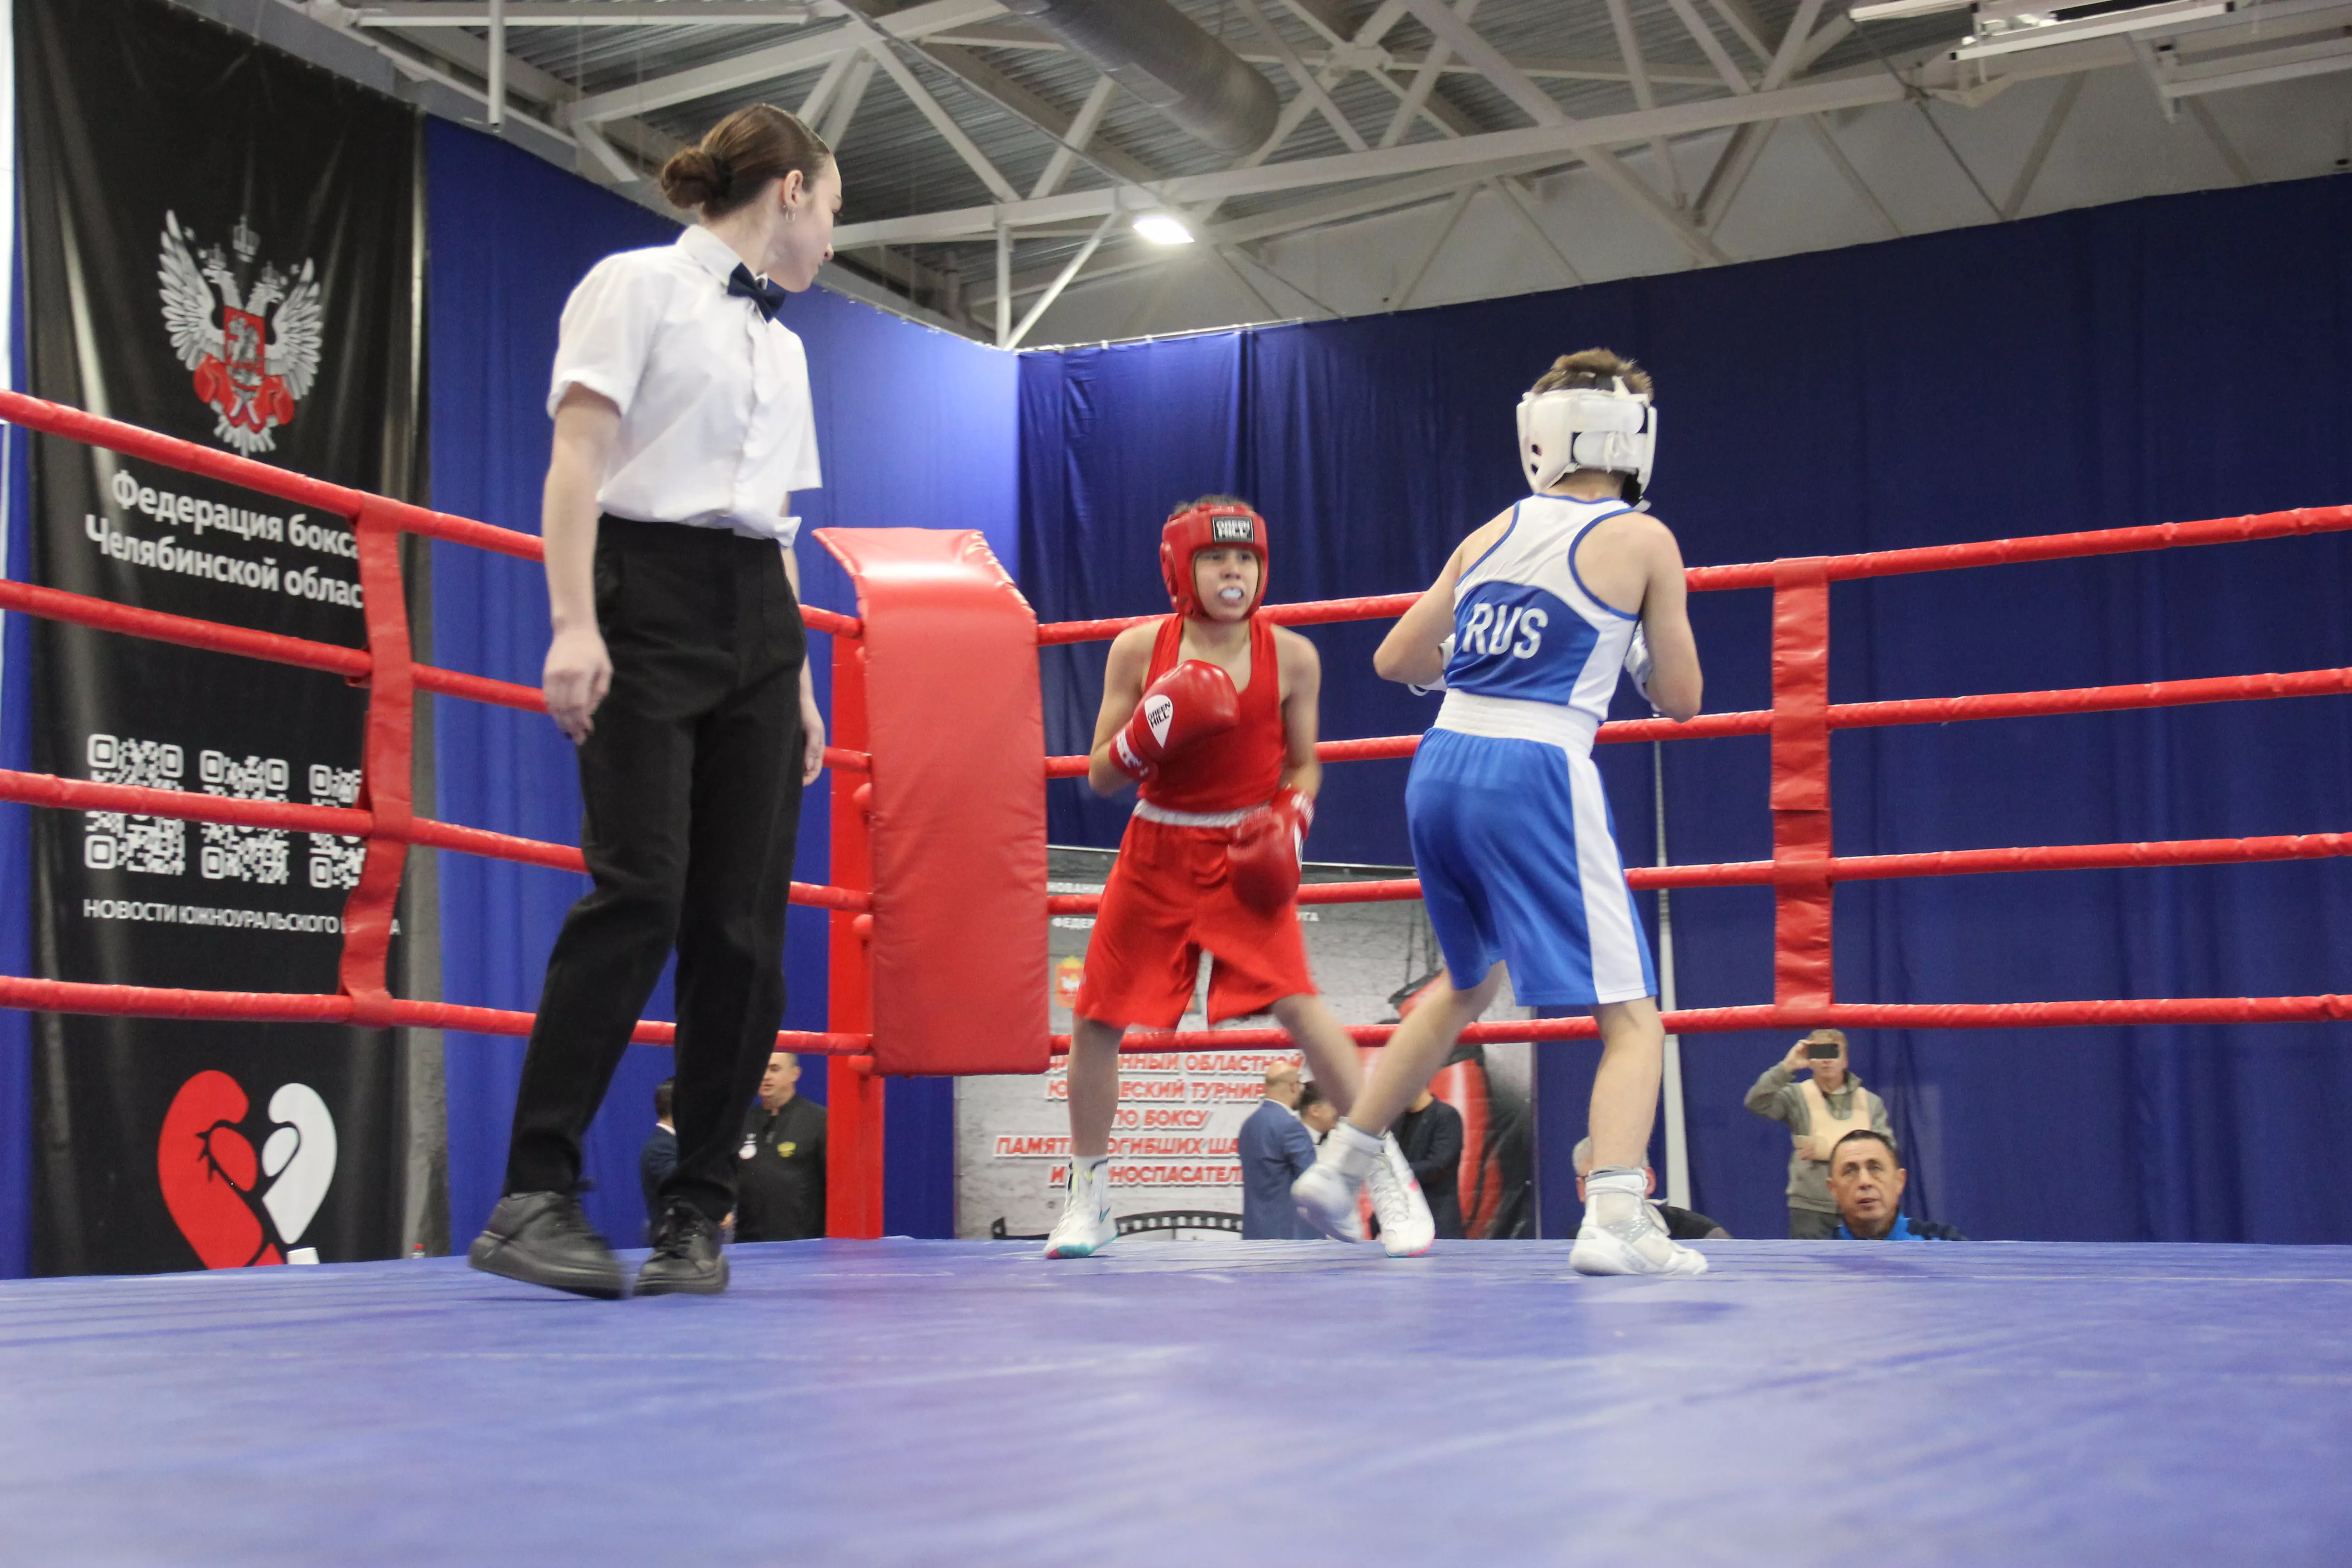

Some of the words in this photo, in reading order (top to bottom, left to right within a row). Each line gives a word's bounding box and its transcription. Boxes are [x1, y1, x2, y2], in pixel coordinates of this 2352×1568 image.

[112, 470, 284, 542] Федерация
[85, 514, 279, 591] Челябинской
[284, 566, 364, 608] облас
[1462, 603, 1548, 659] RUS
[1147, 701, 1171, 721] GREEN
[1150, 710, 1170, 729] HILL
[83, 899, 177, 923] НОВОСТИ
[179, 906, 339, 934] ЮЖНОУРАЛЬСКОГО
[1144, 1110, 1210, 1127] БОКСУ
[1107, 1137, 1203, 1154] ОГИБШИХ
[1050, 1166, 1066, 1183] И
